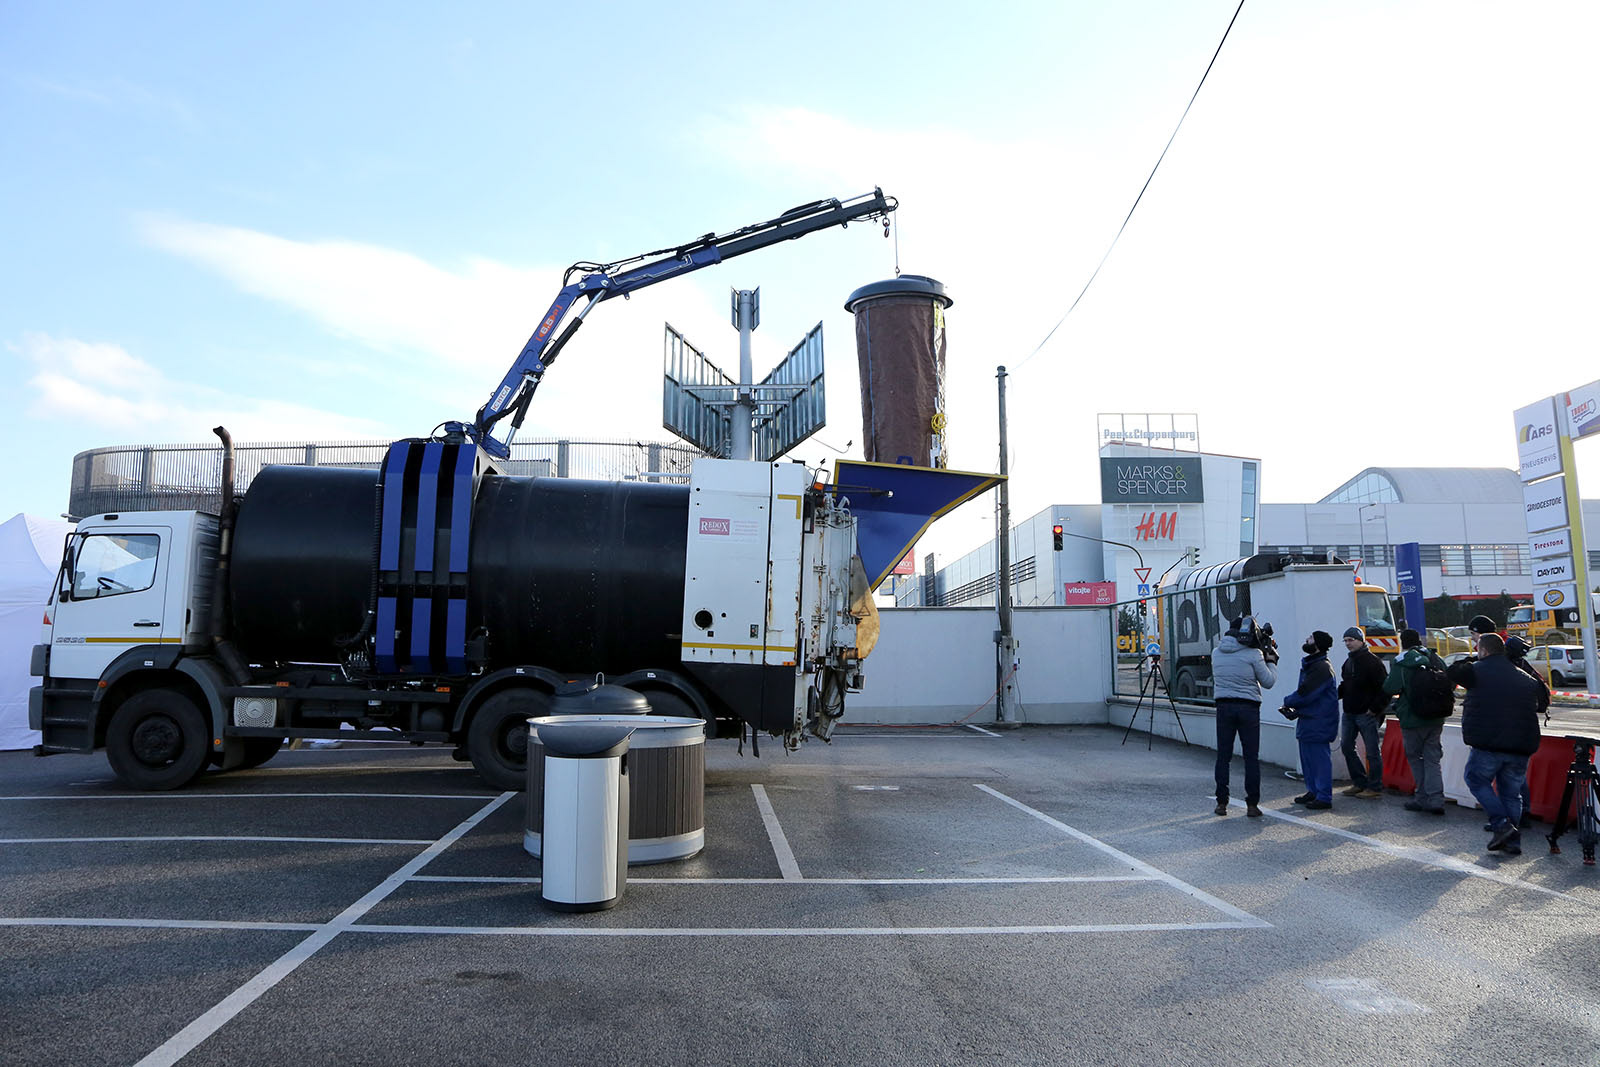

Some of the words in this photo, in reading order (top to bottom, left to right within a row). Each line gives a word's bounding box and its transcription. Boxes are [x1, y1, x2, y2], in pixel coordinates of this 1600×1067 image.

[1531, 424, 1553, 441] ARS
[1521, 453, 1557, 470] PNEUSERVIS
[1117, 480, 1188, 494] SPENCER
[1526, 496, 1562, 512] BRIDGESTONE
[1135, 511, 1178, 542] H&M
[1534, 539, 1564, 551] Firestone
[1537, 566, 1565, 577] DAYTON
[1068, 587, 1091, 595] vitajte
